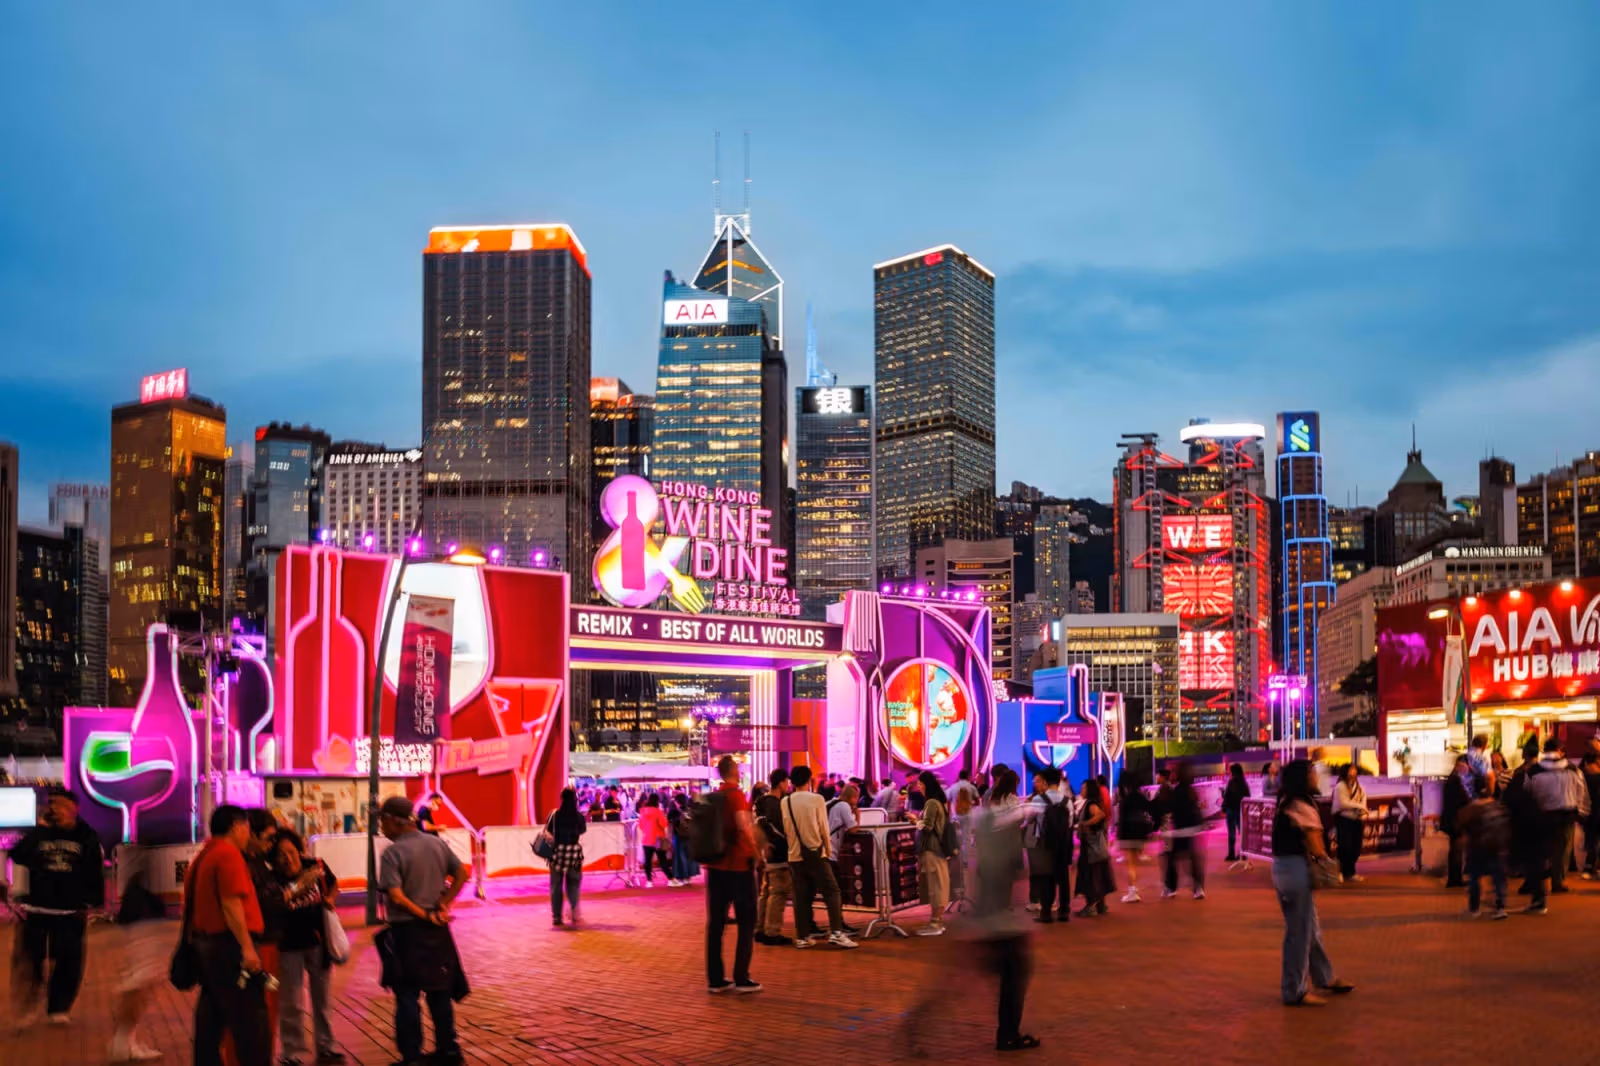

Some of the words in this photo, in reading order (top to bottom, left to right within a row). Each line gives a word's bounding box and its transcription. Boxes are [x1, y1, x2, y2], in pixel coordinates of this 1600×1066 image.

[675, 303, 717, 320] AIA
[329, 454, 353, 464] BANK
[354, 453, 366, 464] OF
[365, 453, 405, 464] AMERICA
[661, 479, 708, 499] HONG
[714, 487, 759, 505] KONG
[660, 496, 773, 547] WINE
[1167, 526, 1222, 549] WE
[692, 540, 788, 587] DINE
[1461, 546, 1504, 558] MANDARIN
[1504, 545, 1544, 557] ORIENTAL
[714, 581, 800, 603] FESTIVAL
[578, 612, 633, 636] REMIX
[661, 619, 702, 640] BEST
[705, 622, 726, 641] OF
[729, 624, 759, 644] ALL
[761, 626, 824, 648] WORLDS
[1469, 606, 1562, 657] AIA
[1570, 592, 1600, 646] Vi
[423, 635, 436, 684] HONG
[1493, 655, 1549, 682] HUB
[423, 686, 435, 736] KONG
